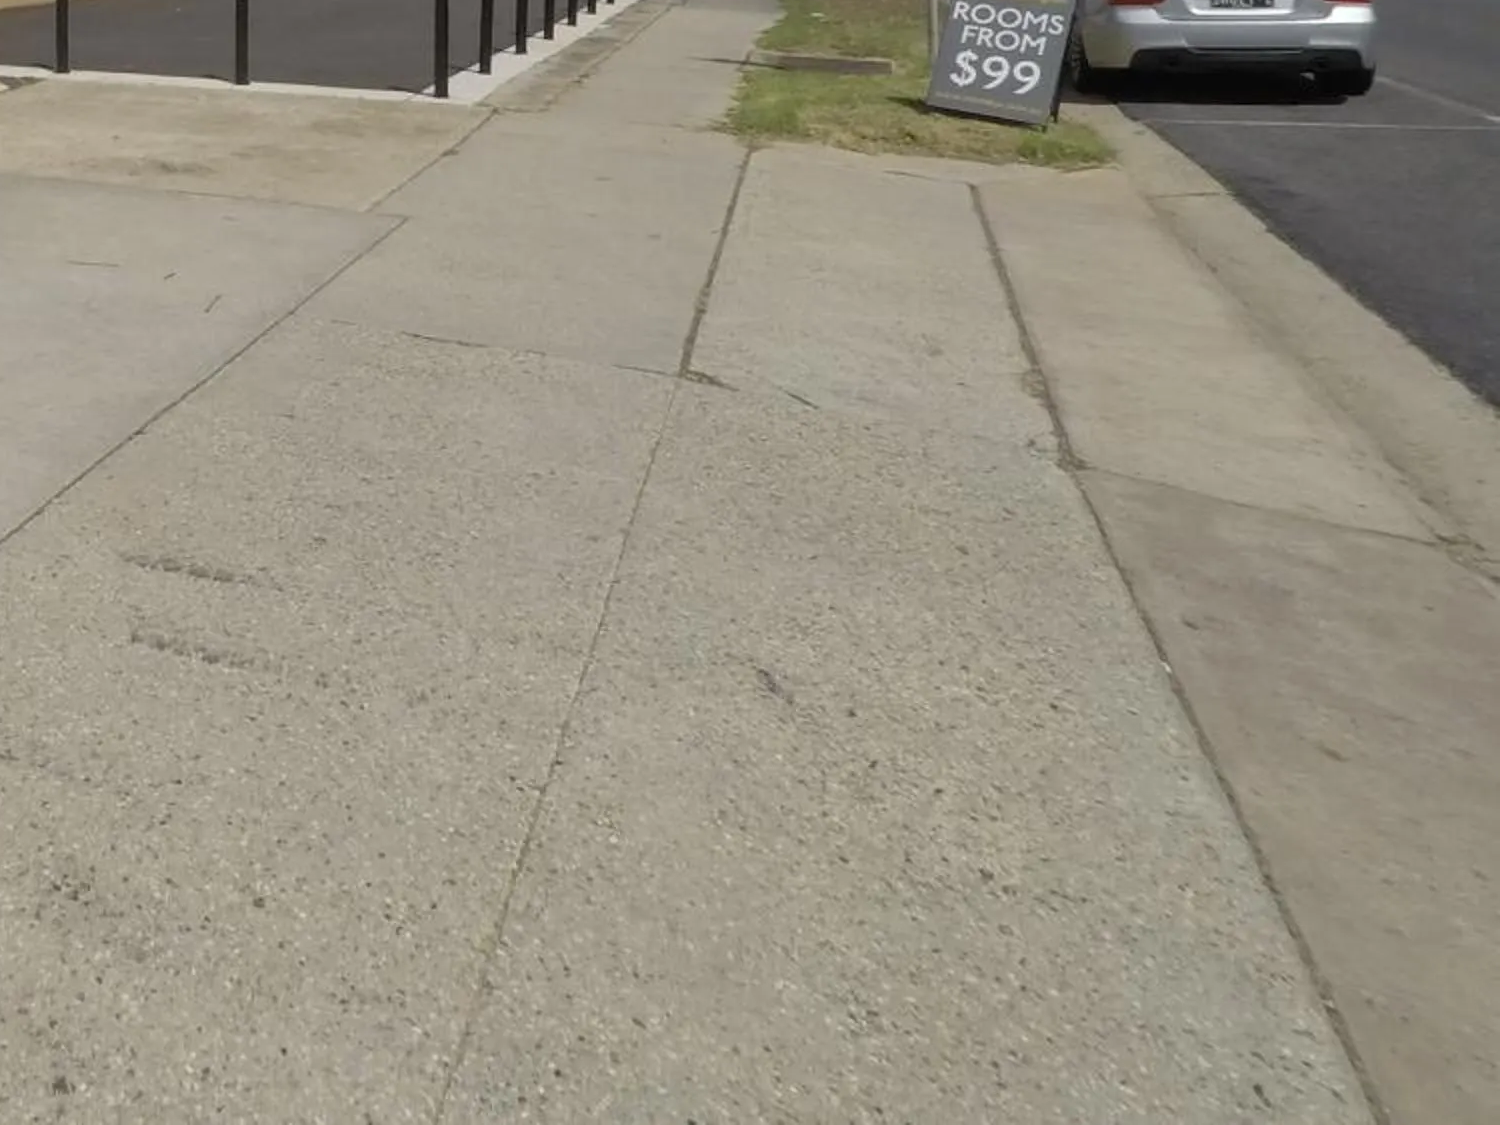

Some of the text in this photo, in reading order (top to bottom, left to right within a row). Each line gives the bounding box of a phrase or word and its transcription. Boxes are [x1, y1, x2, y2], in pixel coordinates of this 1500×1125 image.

[952, 0, 1066, 36] ROOMS
[960, 24, 1048, 56] FROM
[949, 48, 1042, 95] $99
